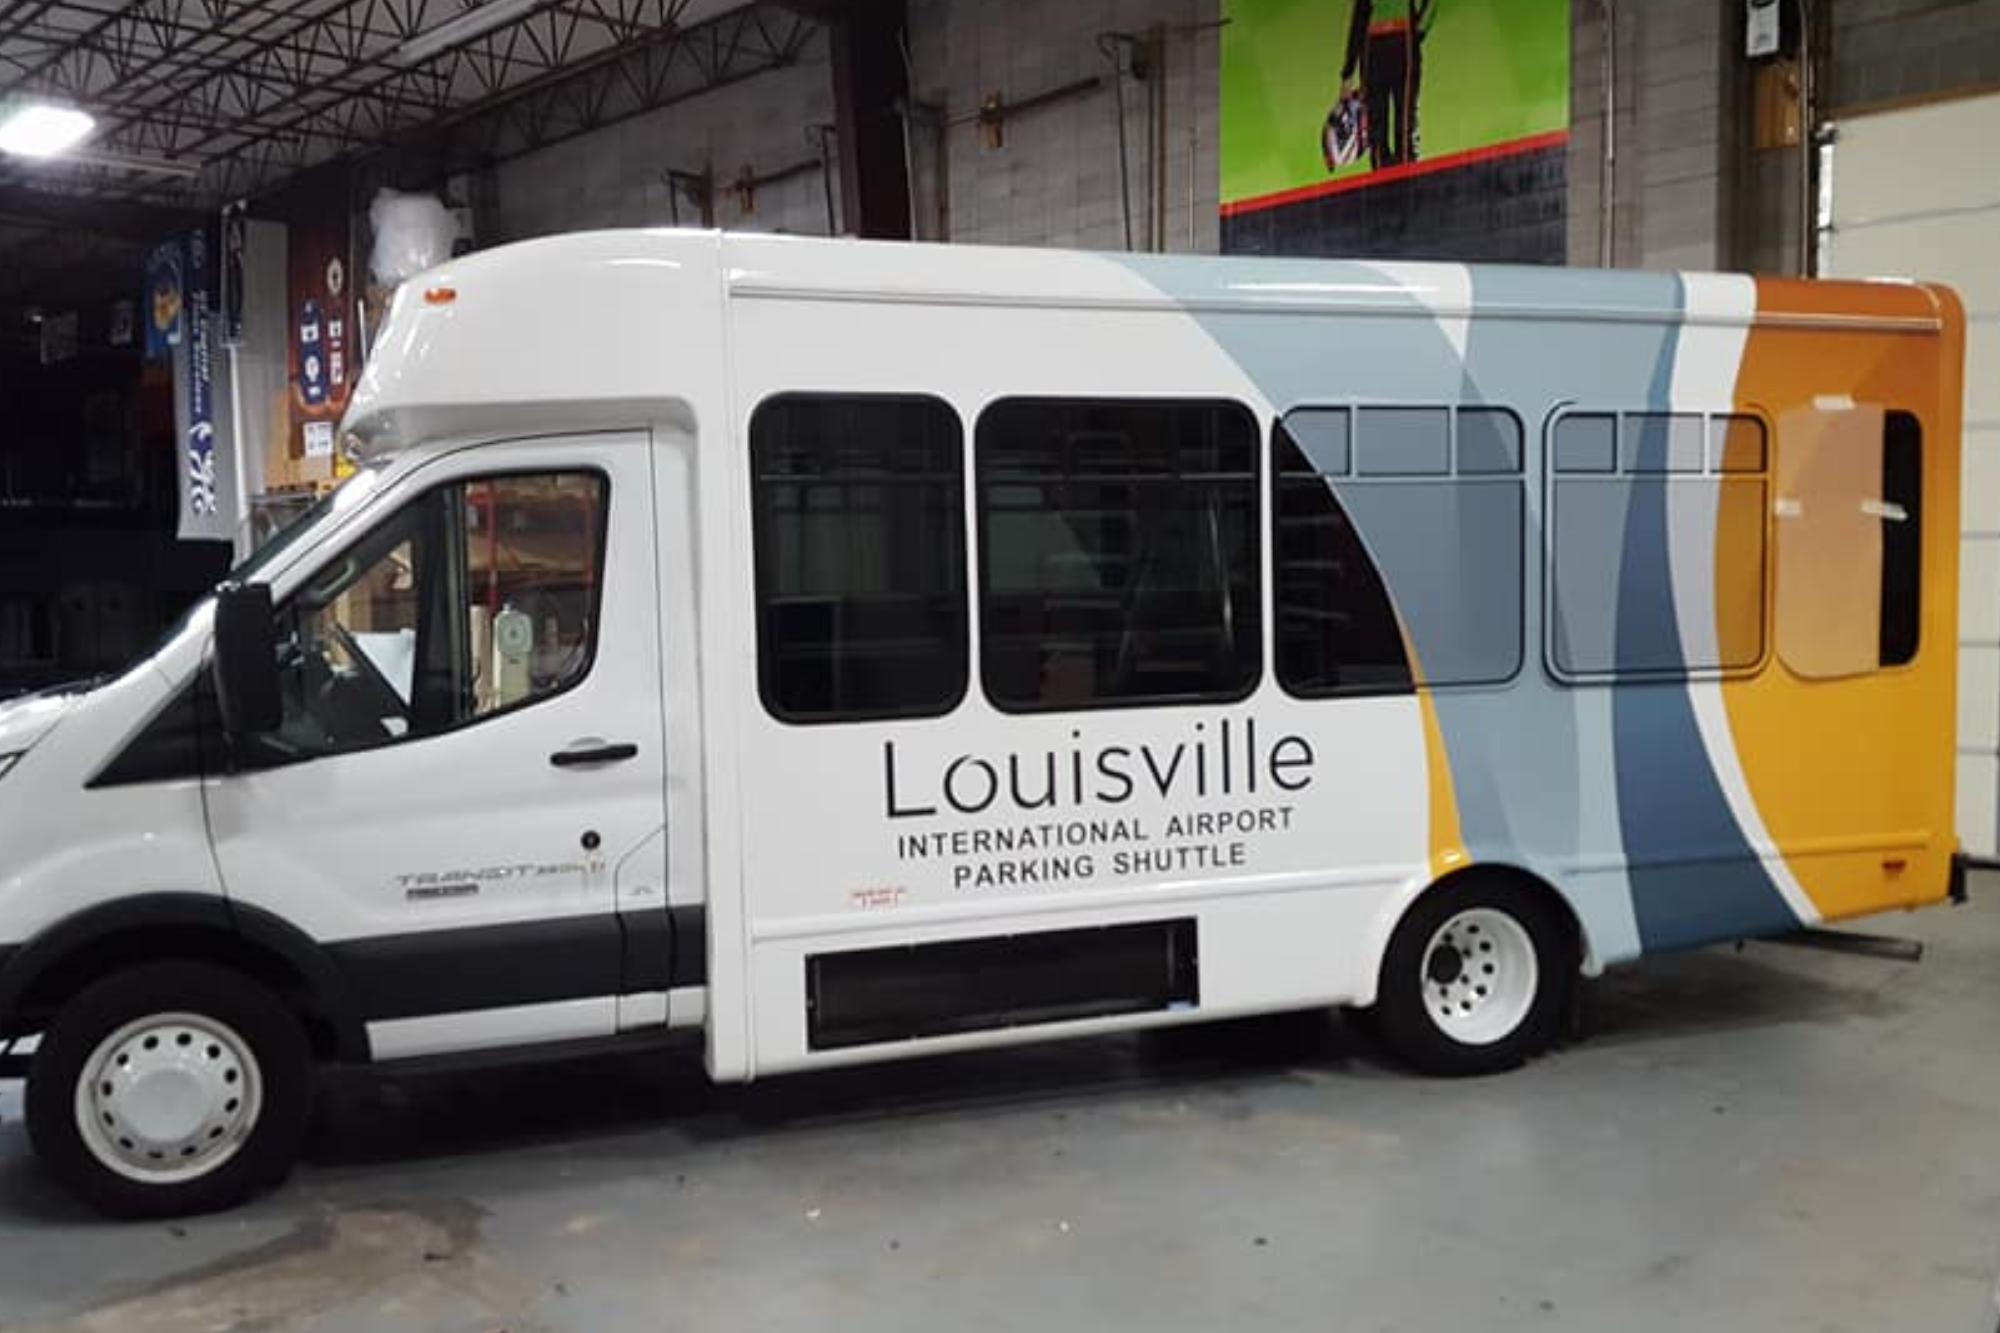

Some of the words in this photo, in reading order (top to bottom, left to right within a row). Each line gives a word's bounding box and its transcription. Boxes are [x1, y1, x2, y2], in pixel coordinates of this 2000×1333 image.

[884, 717, 1314, 819] Louisville
[898, 817, 1147, 859] INTERNATIONAL
[1166, 807, 1292, 837] AIRPORT
[954, 857, 1094, 888] PARKING
[1113, 842, 1244, 875] SHUTTLE
